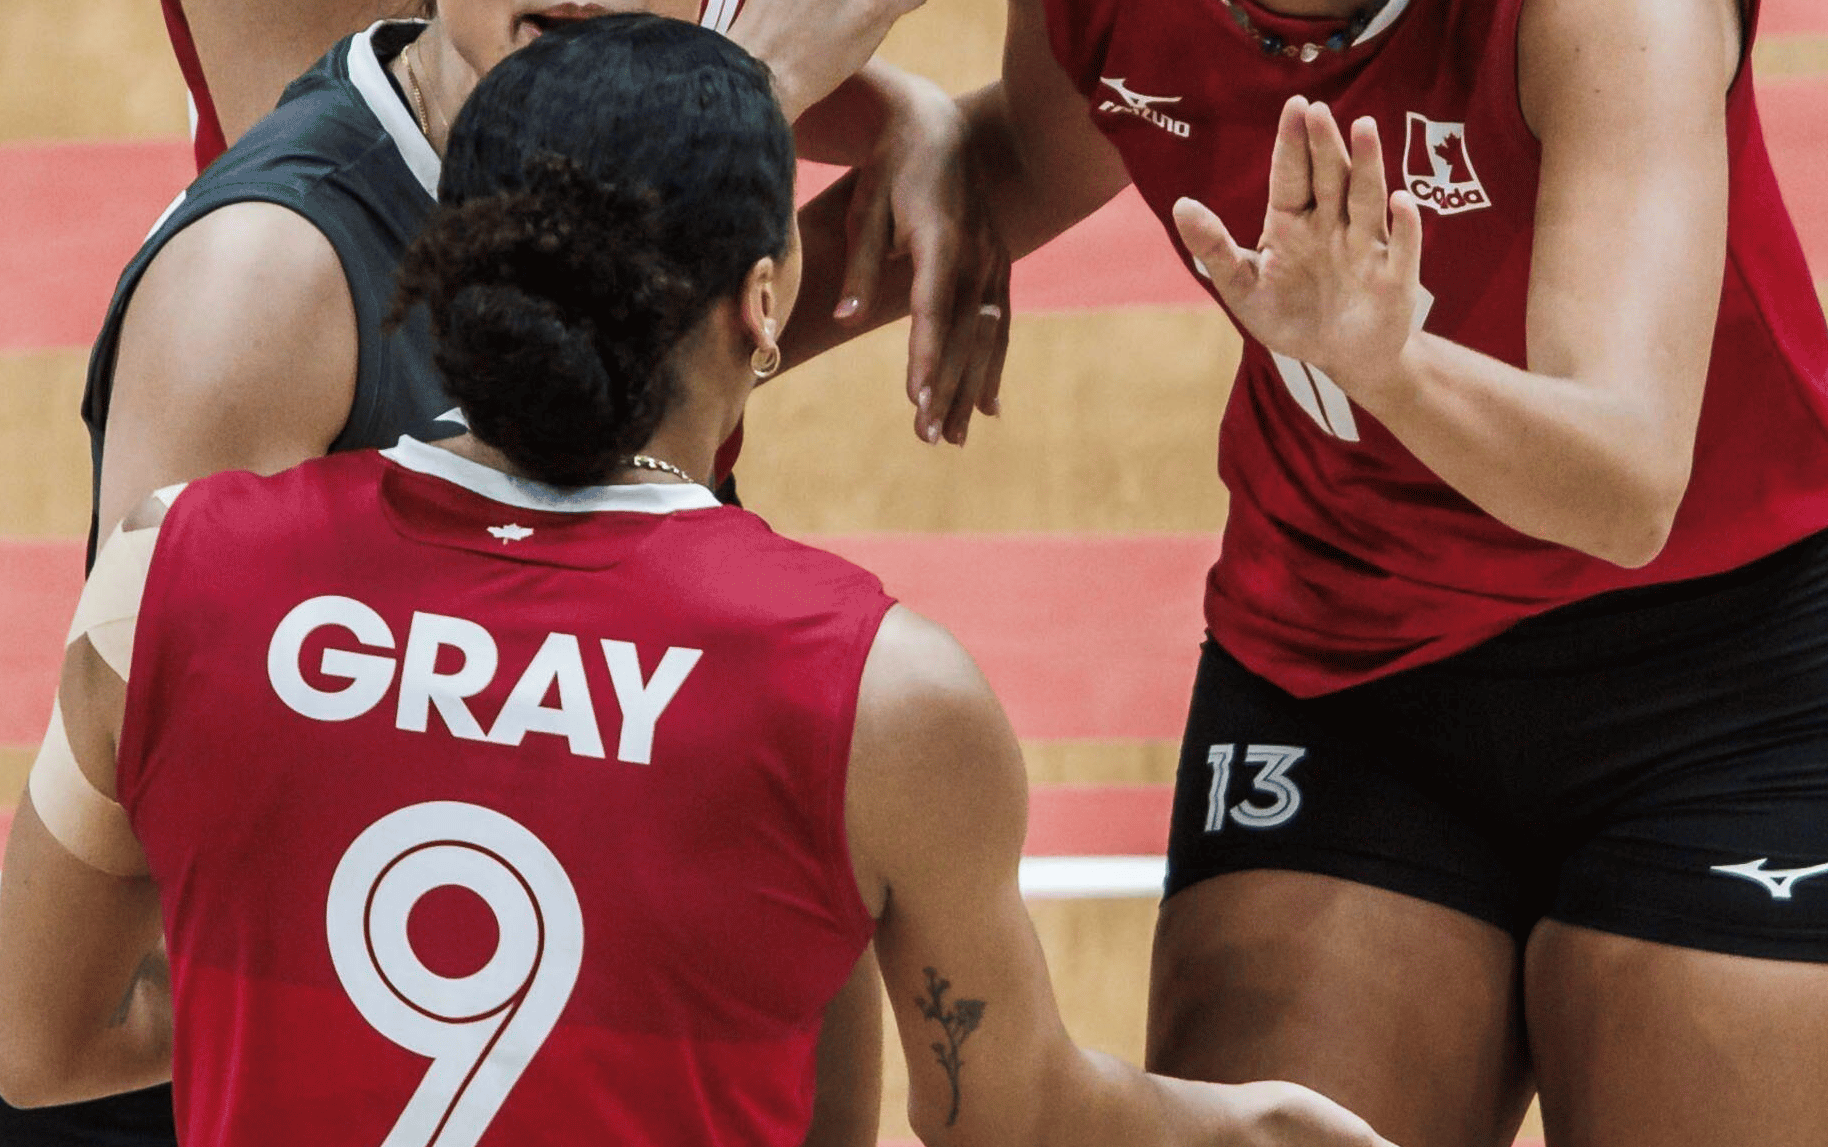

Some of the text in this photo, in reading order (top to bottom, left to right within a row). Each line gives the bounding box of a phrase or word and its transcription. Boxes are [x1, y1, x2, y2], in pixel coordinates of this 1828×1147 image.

[267, 595, 704, 765] GRAY
[1204, 743, 1306, 832] 13
[326, 800, 584, 1147] 9
